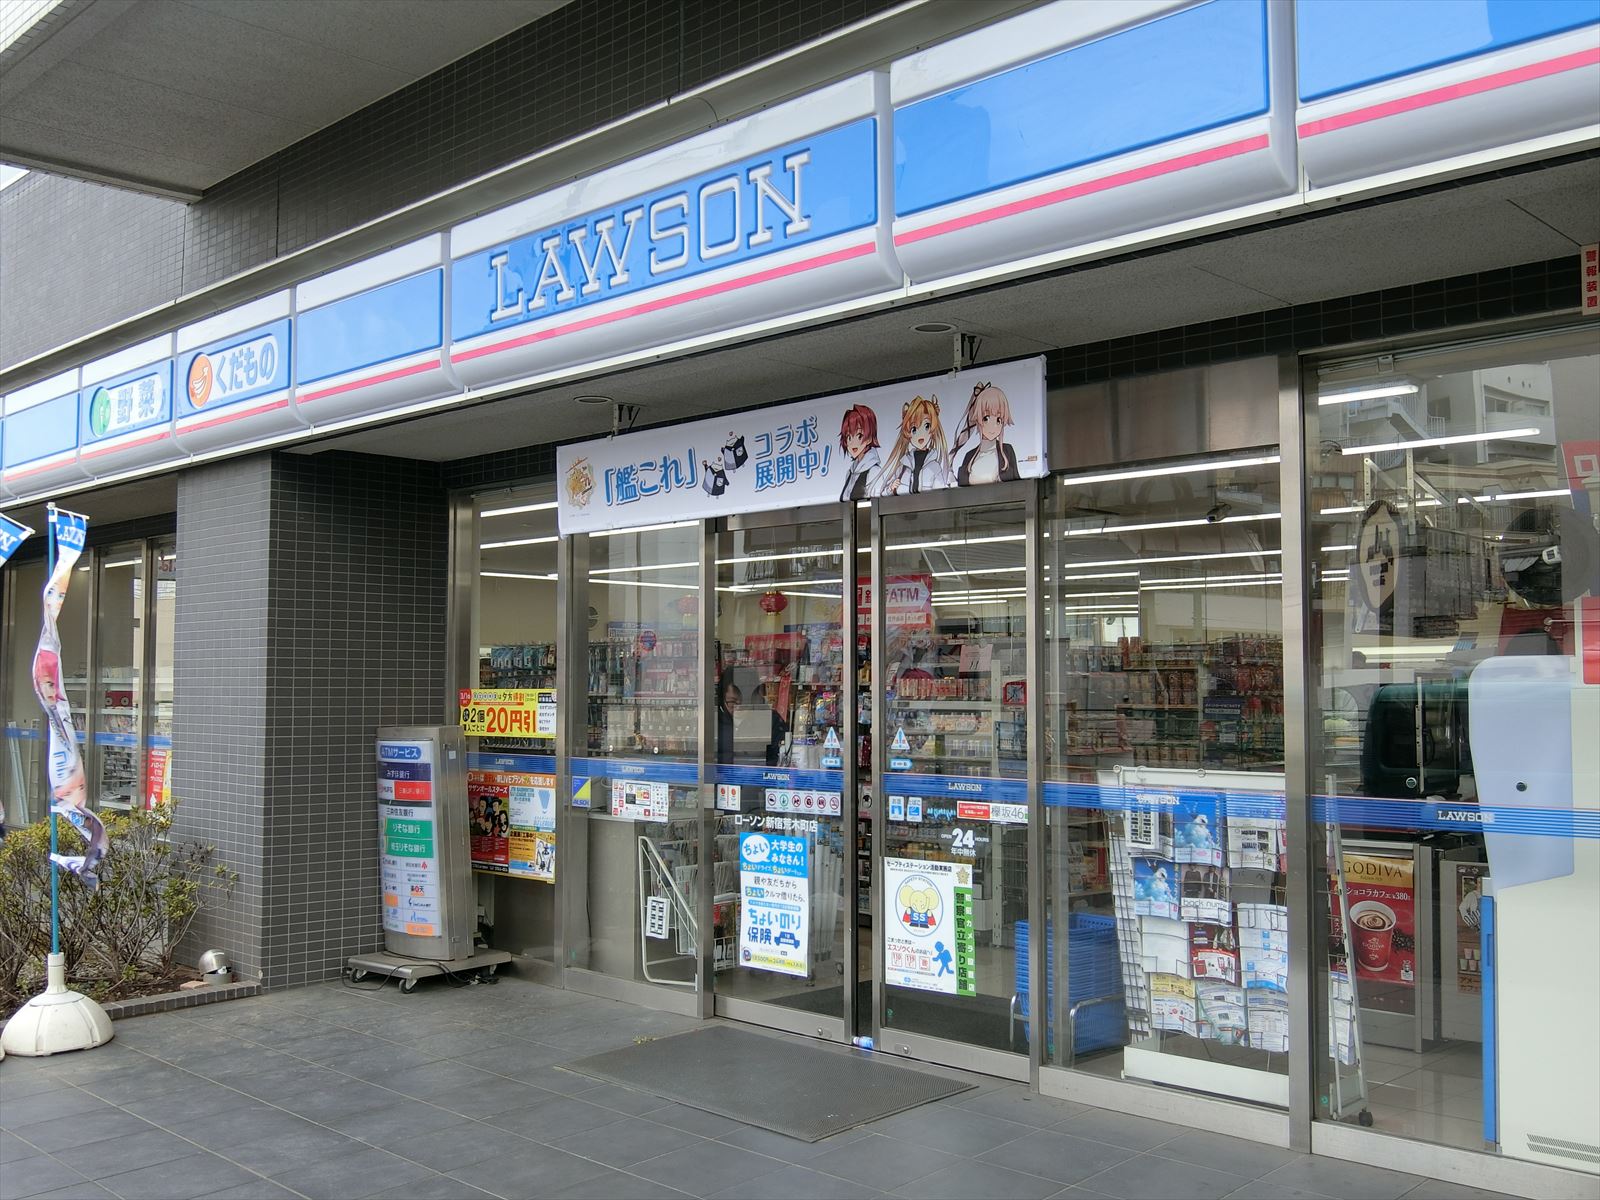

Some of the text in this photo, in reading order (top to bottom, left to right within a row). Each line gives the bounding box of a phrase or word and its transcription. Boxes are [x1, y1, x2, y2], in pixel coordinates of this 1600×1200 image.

[490, 148, 810, 323] LAWSON
[1586, 250, 1598, 308] 警報装置
[215, 342, 275, 394] くだもの
[116, 378, 155, 424] 野菜
[755, 415, 818, 459] コラボ
[604, 447, 698, 506] 「艦これ」
[755, 445, 832, 492] 展開中!
[486, 707, 536, 733] 20円引
[381, 746, 419, 758] ATMサービス
[468, 785, 509, 794] サザンオールスターズ
[948, 782, 982, 792] LAWSON
[392, 823, 421, 834] りそな銀行
[735, 814, 818, 833] ローソン新宿荒木町店
[771, 839, 803, 853] 大学生の
[952, 828, 975, 848] 24
[743, 843, 769, 856] ちょい
[951, 848, 977, 858] 年中無休
[771, 853, 805, 867] みなさん!
[1343, 860, 1402, 878] GODIVA
[754, 876, 798, 889] 親や友だちから
[1346, 887, 1390, 899] ショコラカフェ
[748, 903, 801, 931] ちょいのり
[913, 913, 926, 921] SS
[747, 927, 772, 945] 保険
